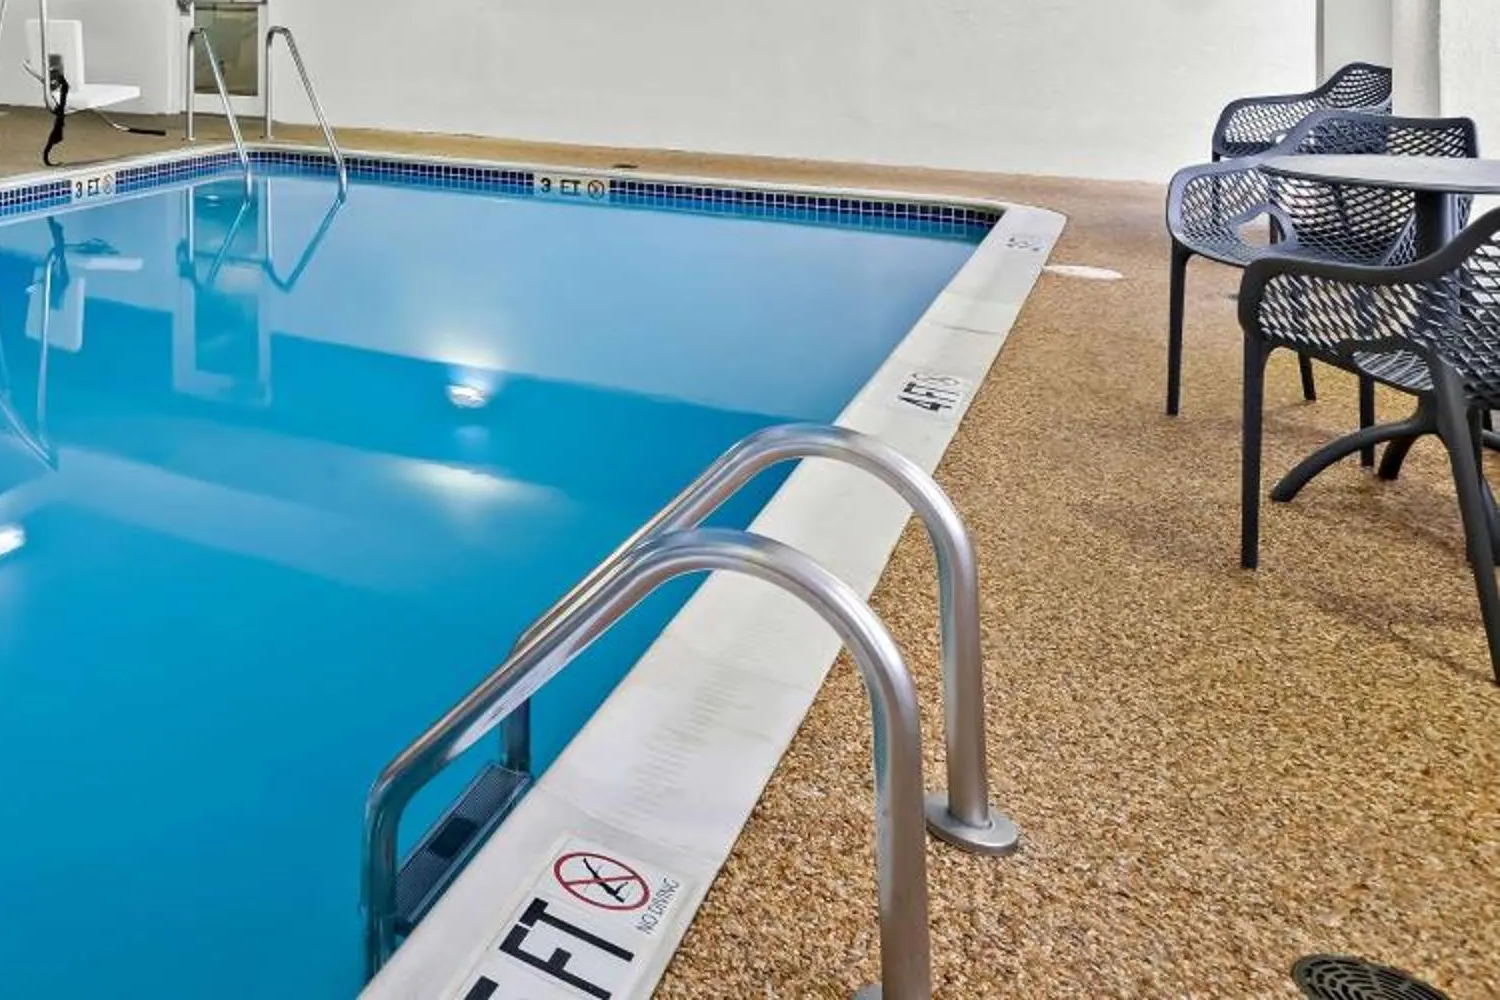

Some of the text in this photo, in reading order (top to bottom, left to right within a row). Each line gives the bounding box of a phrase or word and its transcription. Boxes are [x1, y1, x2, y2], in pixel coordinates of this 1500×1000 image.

[633, 877, 680, 935] NO DIVING
[499, 898, 635, 1000] FT
